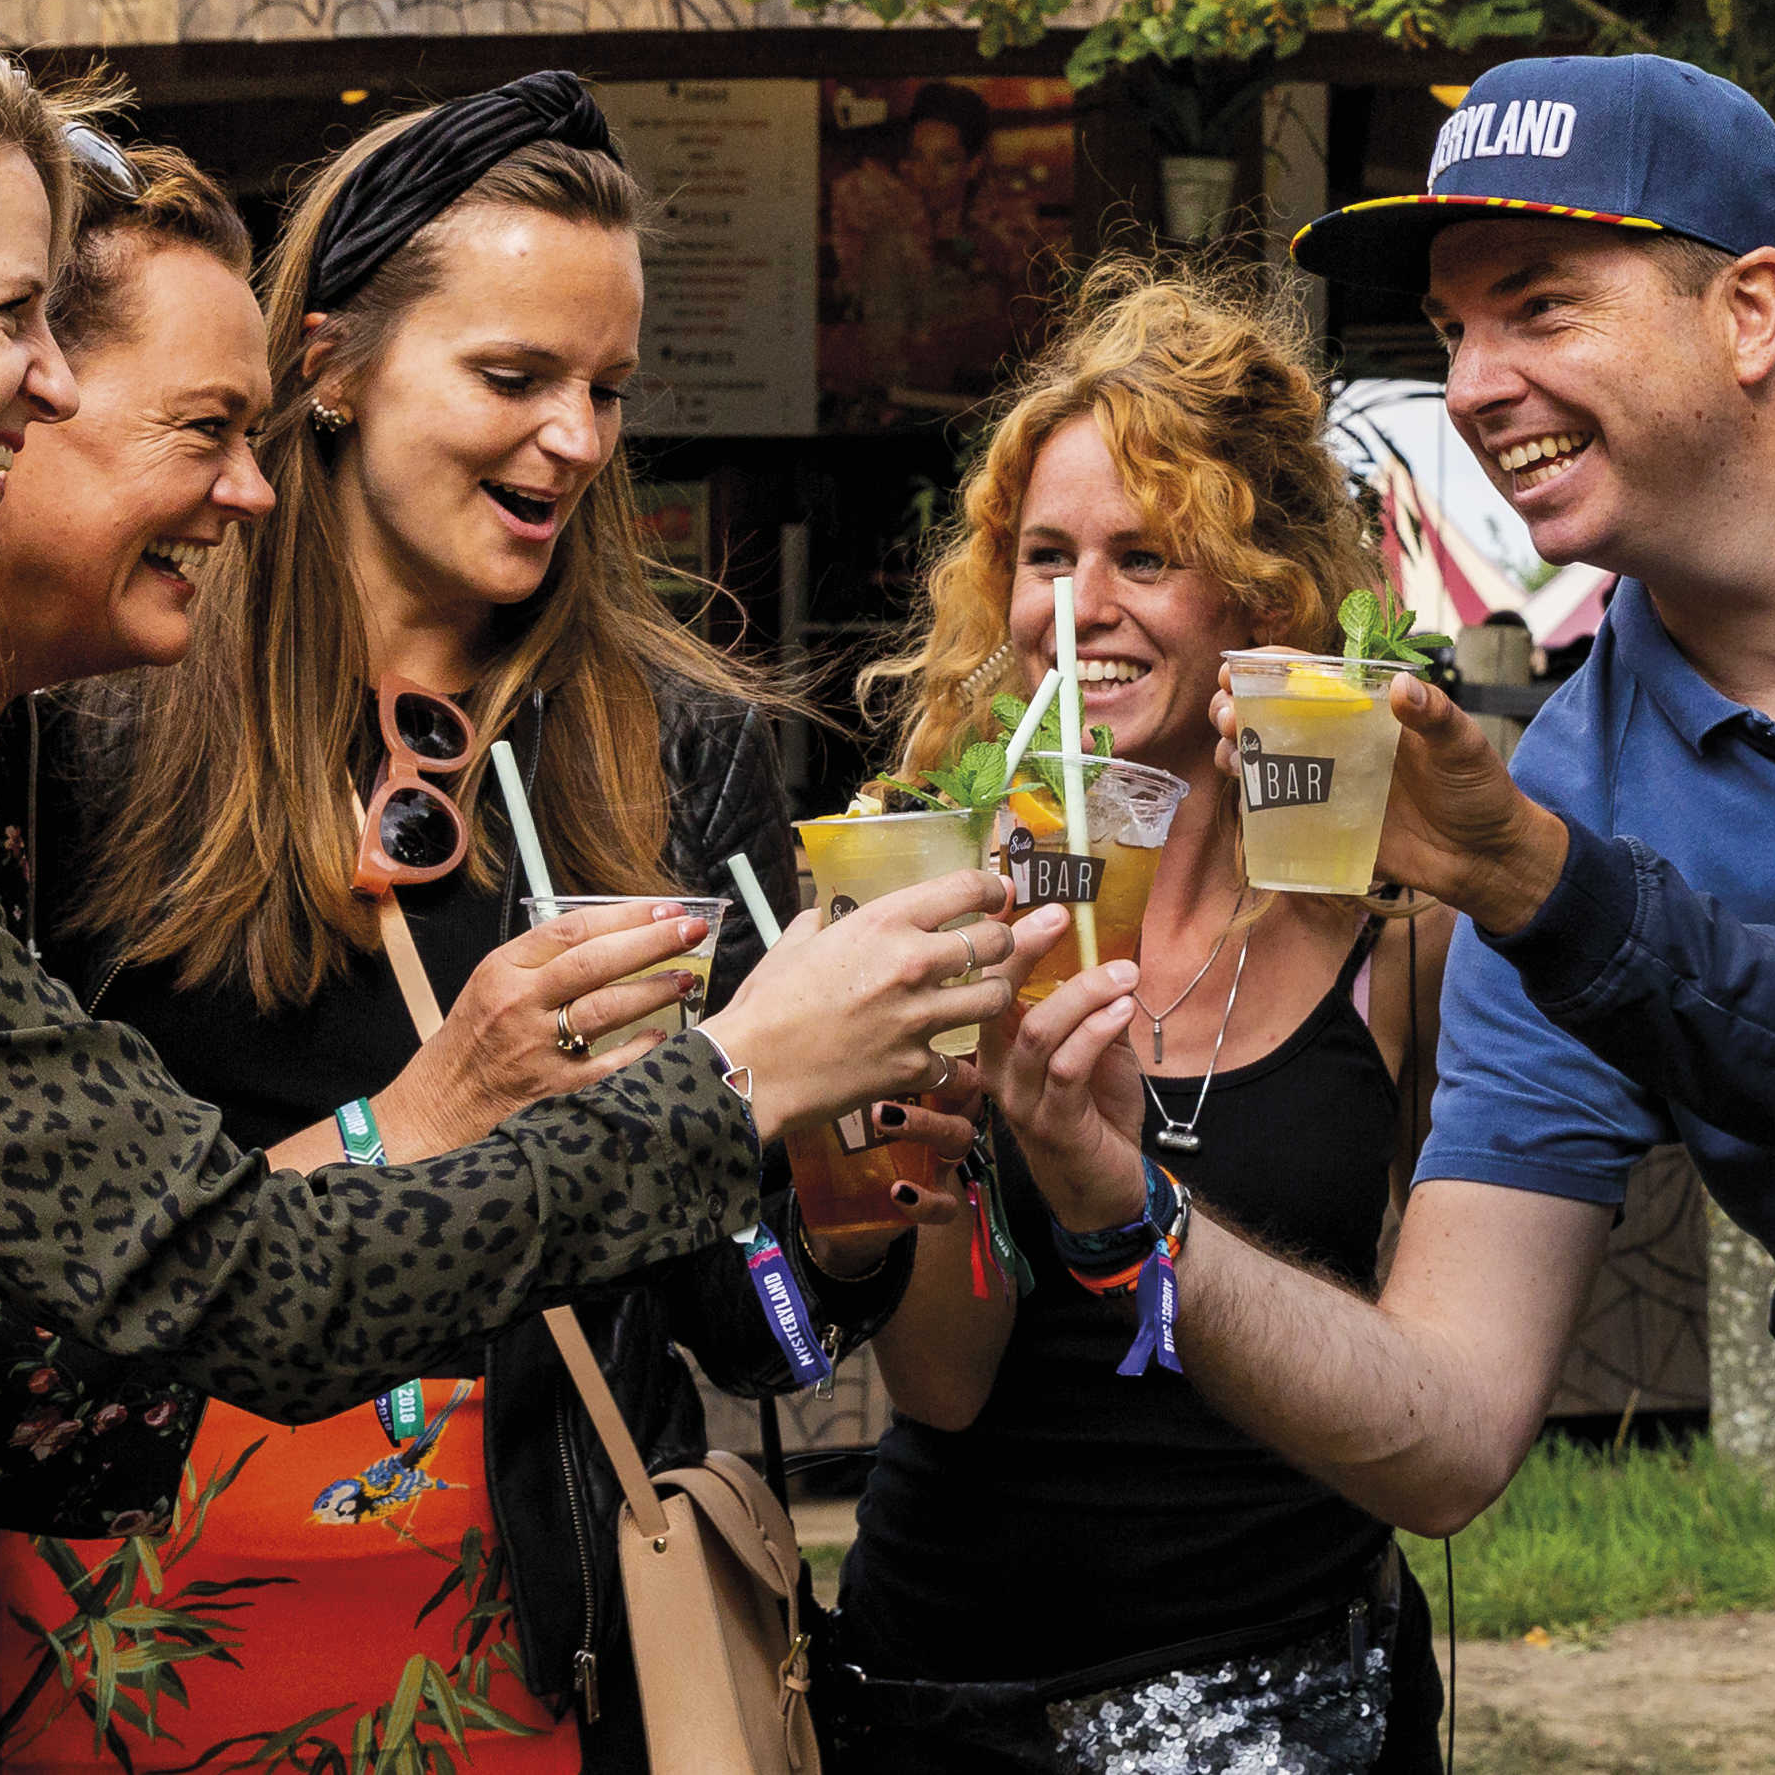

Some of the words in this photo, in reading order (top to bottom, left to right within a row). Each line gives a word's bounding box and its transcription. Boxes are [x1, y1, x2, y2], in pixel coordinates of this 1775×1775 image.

[1240, 735, 1260, 755] Soda
[1266, 761, 1322, 801] BAR
[1009, 835, 1032, 855] Soda
[1037, 859, 1093, 900] BAR
[763, 1271, 815, 1367] MYSTERYLAND
[397, 1387, 417, 1424] 2018
